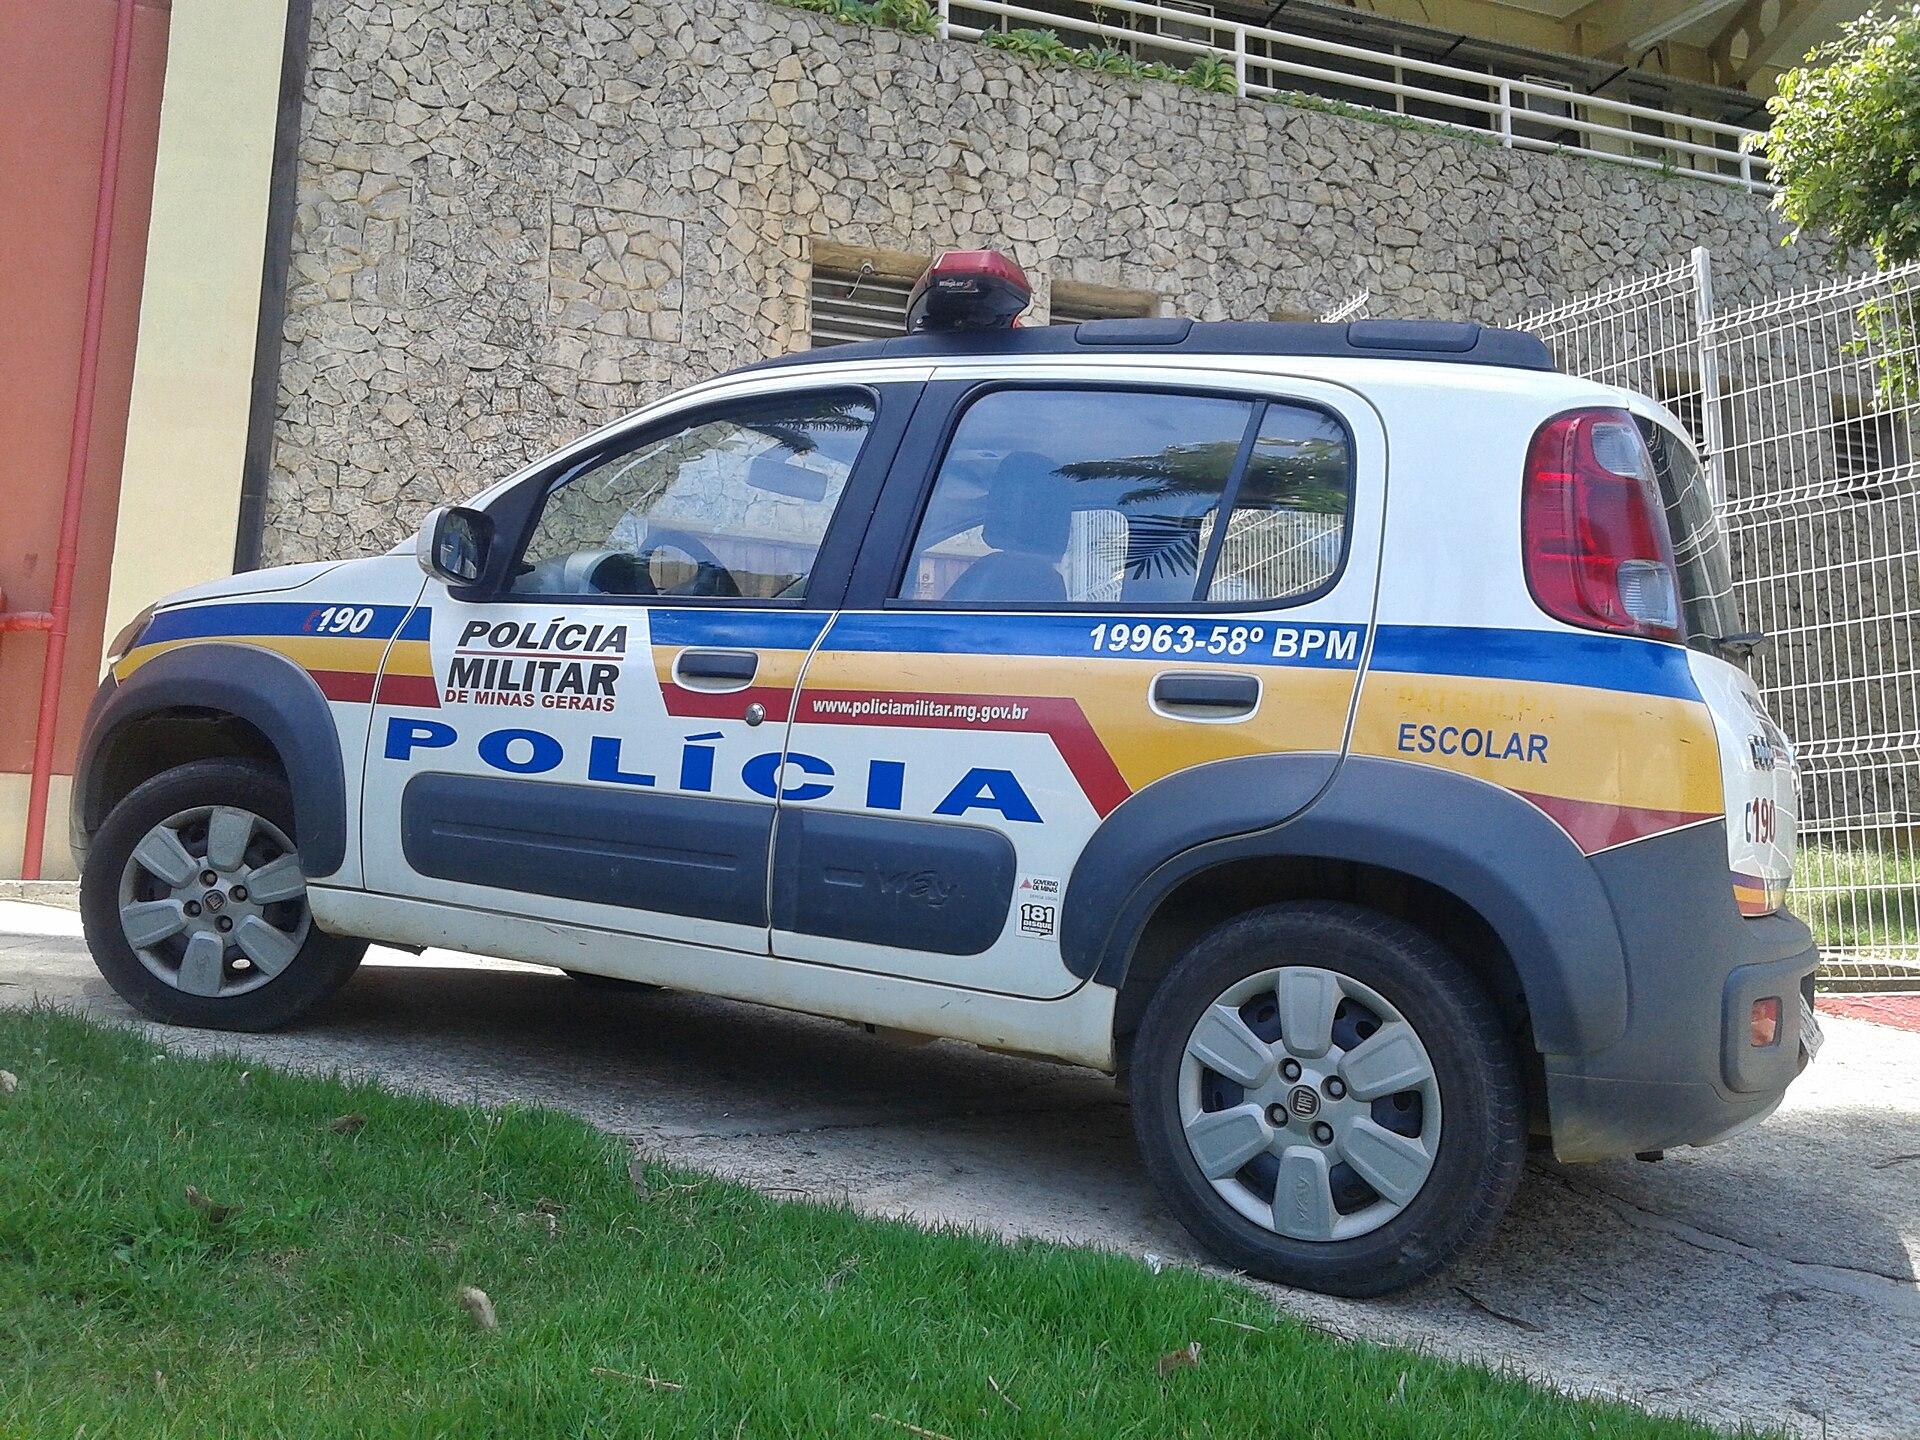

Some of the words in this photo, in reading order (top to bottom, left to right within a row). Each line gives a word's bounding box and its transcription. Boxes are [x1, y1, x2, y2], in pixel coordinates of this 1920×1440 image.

[315, 606, 374, 634] 190
[457, 616, 628, 653] POLÍCIA
[1272, 628, 1358, 660] BPM
[447, 657, 620, 696] MILITAR
[444, 689, 469, 704] DE
[474, 690, 535, 707] MINAS
[541, 694, 615, 712] GERAIS
[813, 698, 1029, 722] www.policiamilitar.mg.gov.br
[1397, 723, 1548, 764] ESCOLAR
[383, 716, 1045, 824] POLÍCIA
[1752, 796, 1776, 844] 190
[1032, 879, 1058, 887] GOVERNO
[1022, 905, 1053, 922] 181
[1023, 920, 1053, 930] DISQUE
